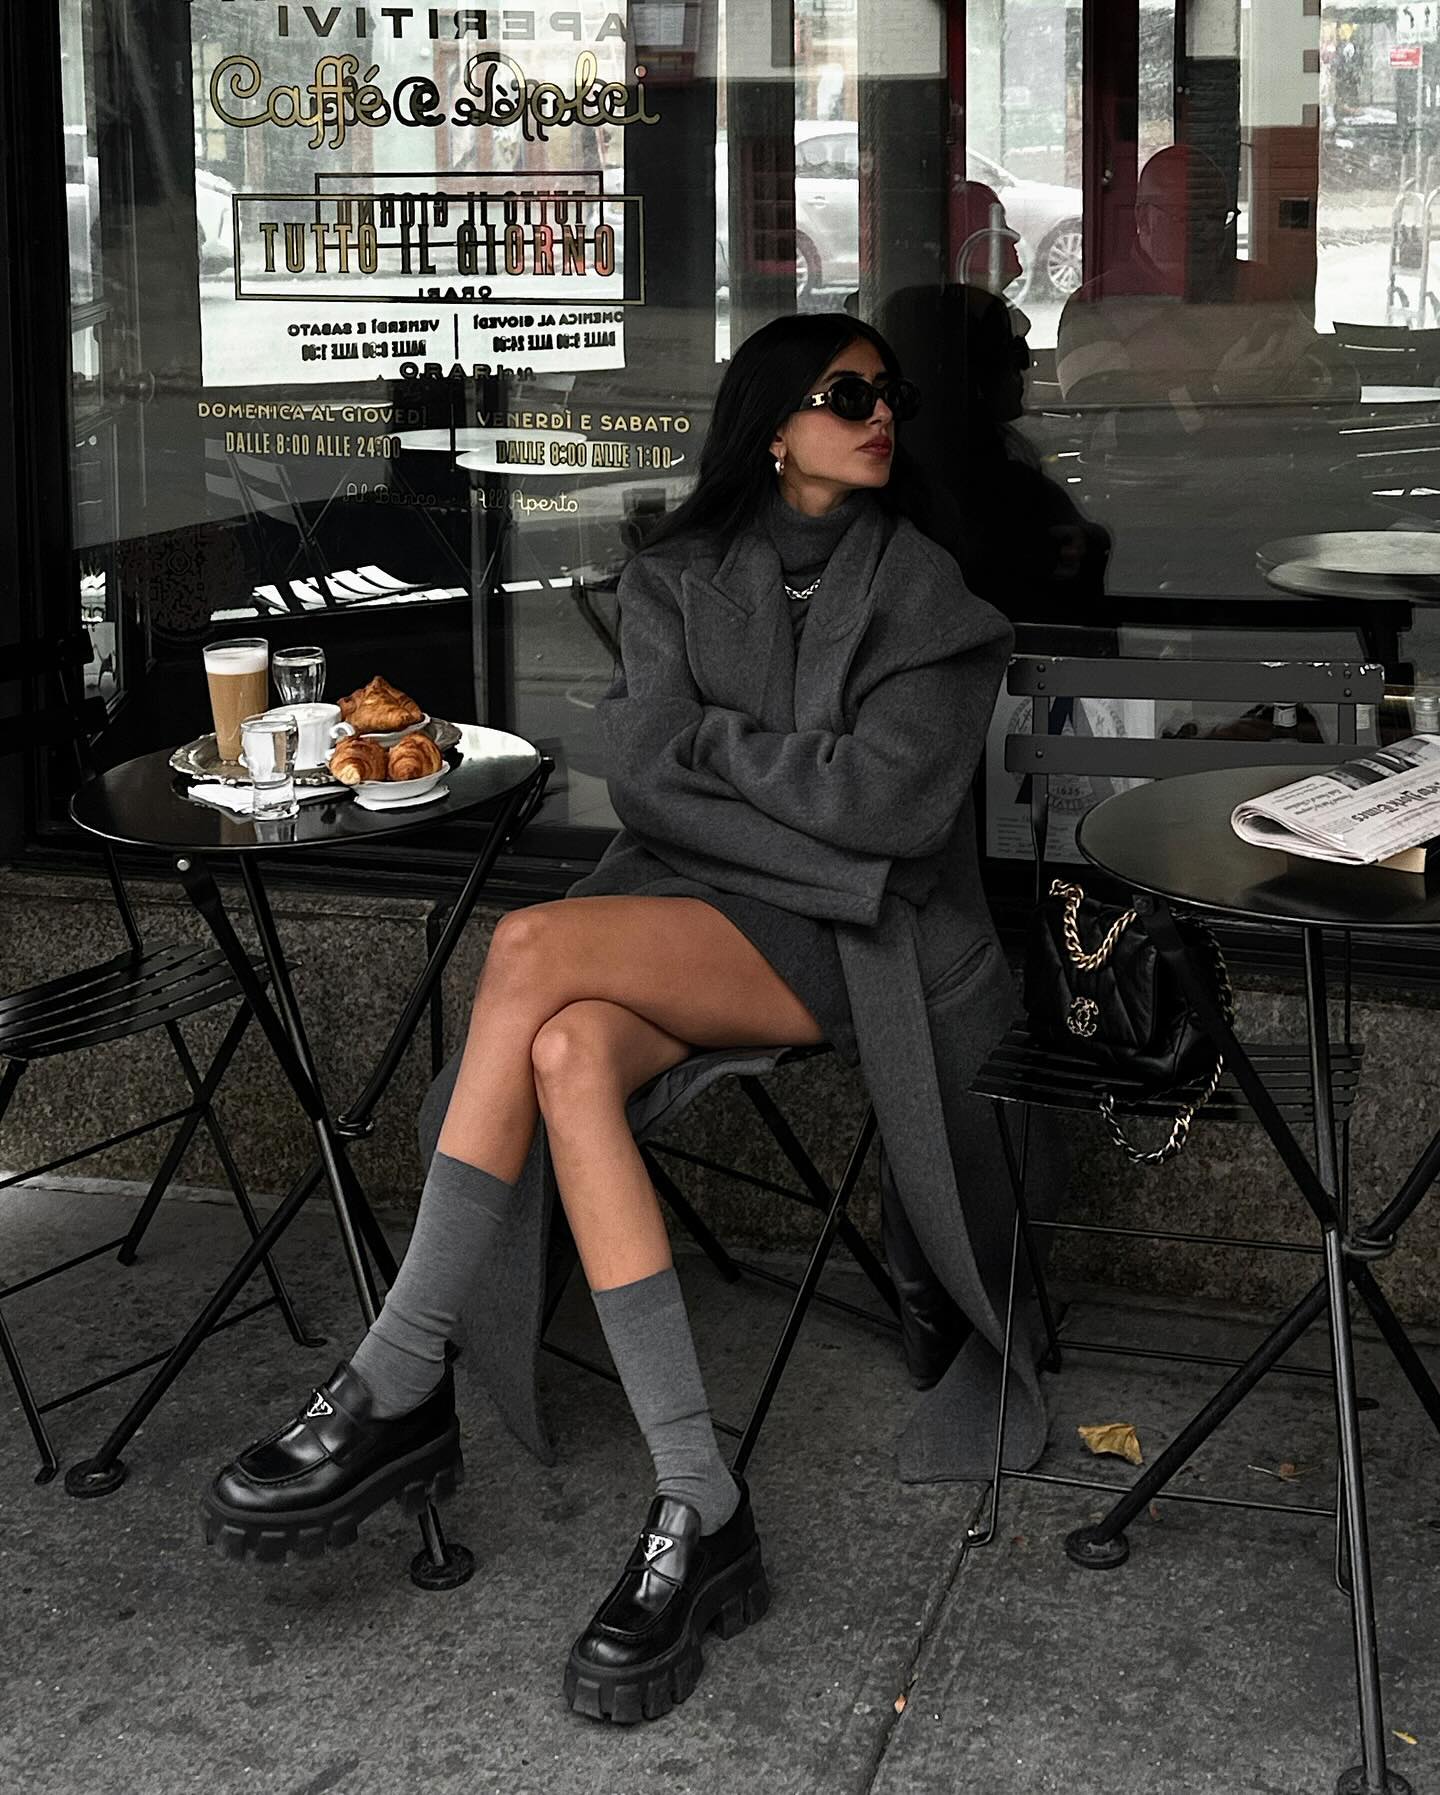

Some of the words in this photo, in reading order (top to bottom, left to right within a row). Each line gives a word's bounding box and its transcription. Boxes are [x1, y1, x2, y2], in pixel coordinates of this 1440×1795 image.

[464, 50, 661, 127] Dolci
[259, 222, 378, 275] TUTTO
[399, 223, 437, 275] IL
[456, 223, 616, 276] GIORNO
[399, 361, 504, 380] ORARI
[197, 402, 306, 421] DOMENICA
[310, 405, 336, 422] AL
[341, 405, 428, 426] GIOVEDÌ
[476, 409, 572, 430] VENERDÌ
[579, 413, 592, 431] E
[600, 414, 691, 434] SABATO
[224, 431, 271, 455] DALLE
[275, 433, 310, 456] 8:00
[316, 433, 351, 458] ALLE
[356, 435, 402, 460] 24:00
[495, 439, 546, 465] DALLE
[550, 441, 587, 467] 8:00
[591, 442, 631, 468] ALLE
[636, 444, 673, 469] 1:00
